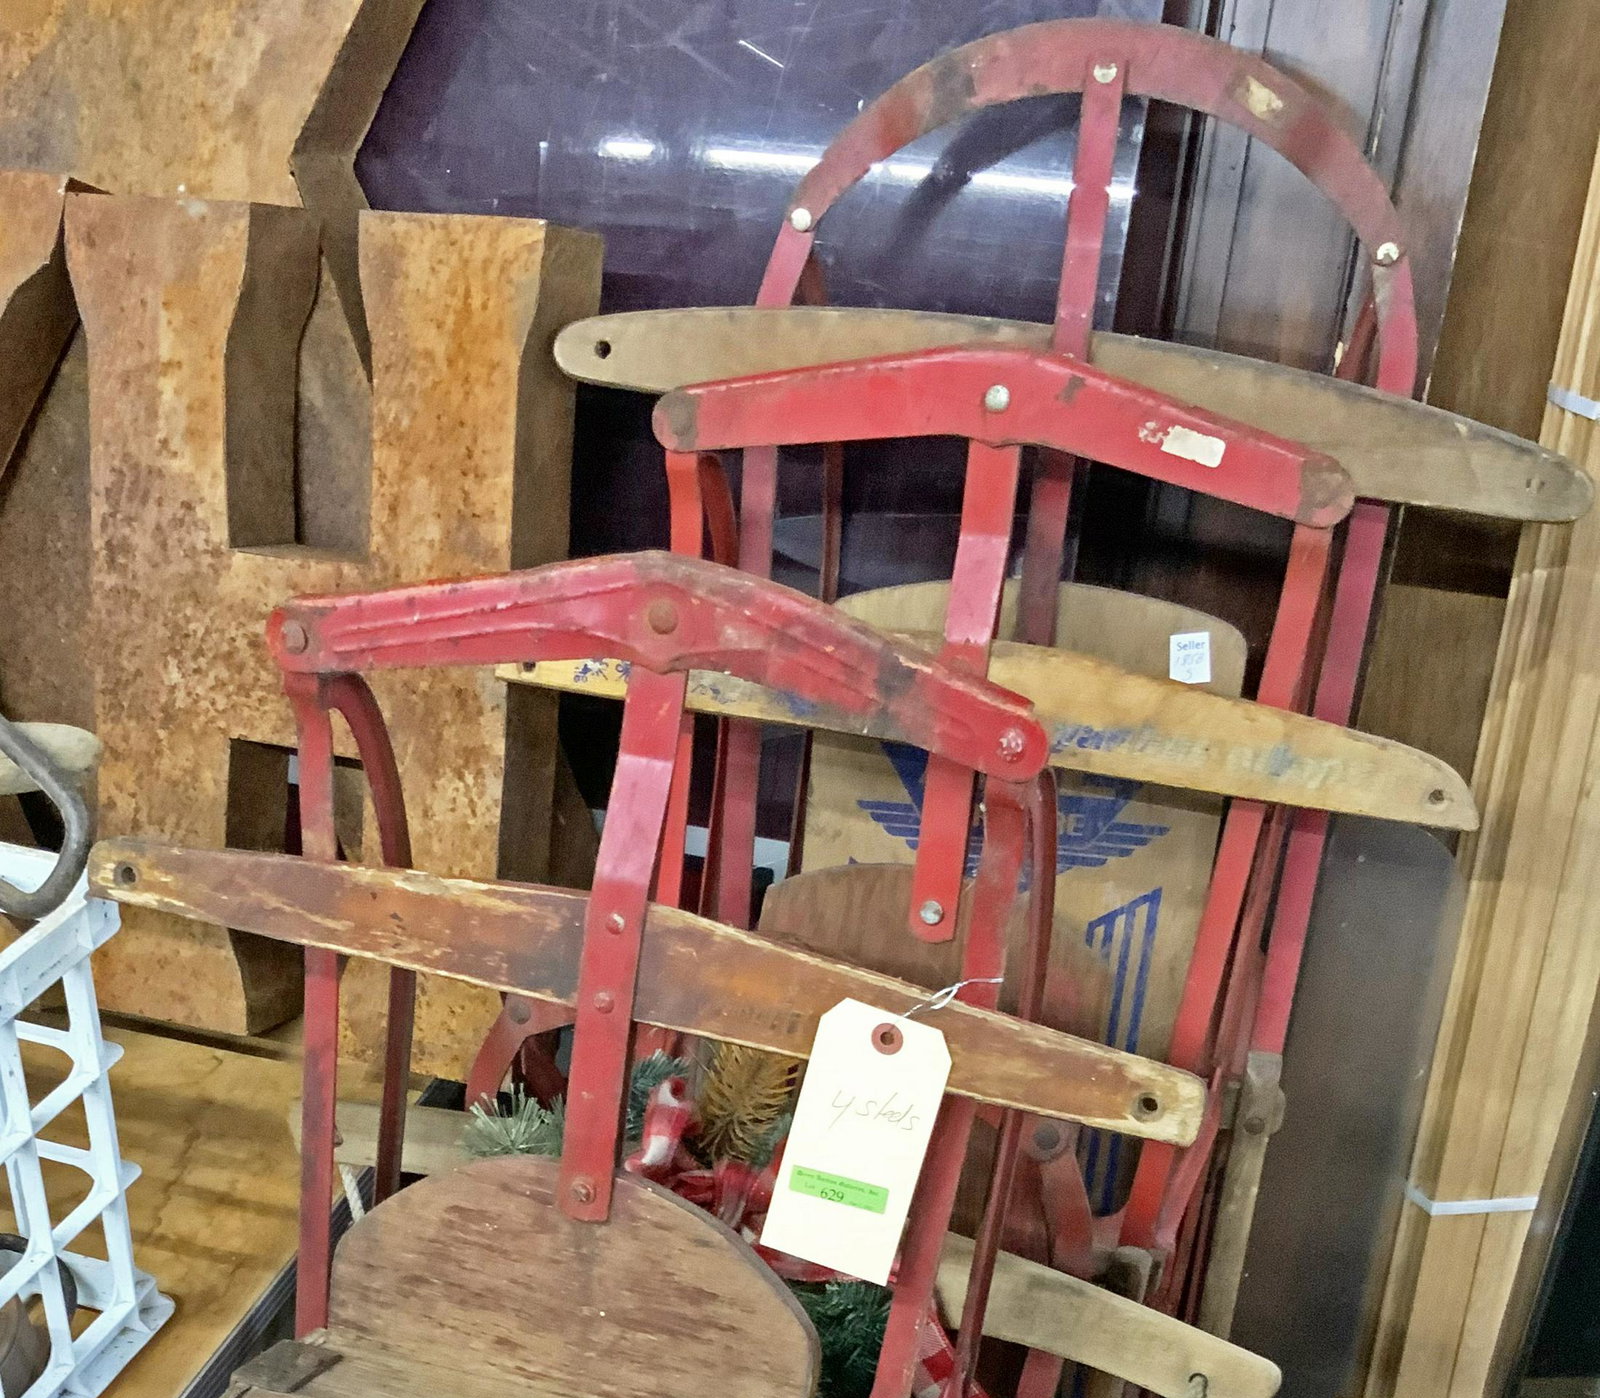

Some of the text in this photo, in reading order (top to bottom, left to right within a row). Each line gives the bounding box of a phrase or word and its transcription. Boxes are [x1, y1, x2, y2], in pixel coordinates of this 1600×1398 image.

[1176, 640, 1206, 652] Seller
[829, 1090, 856, 1132] 4
[820, 1187, 845, 1203] 629
